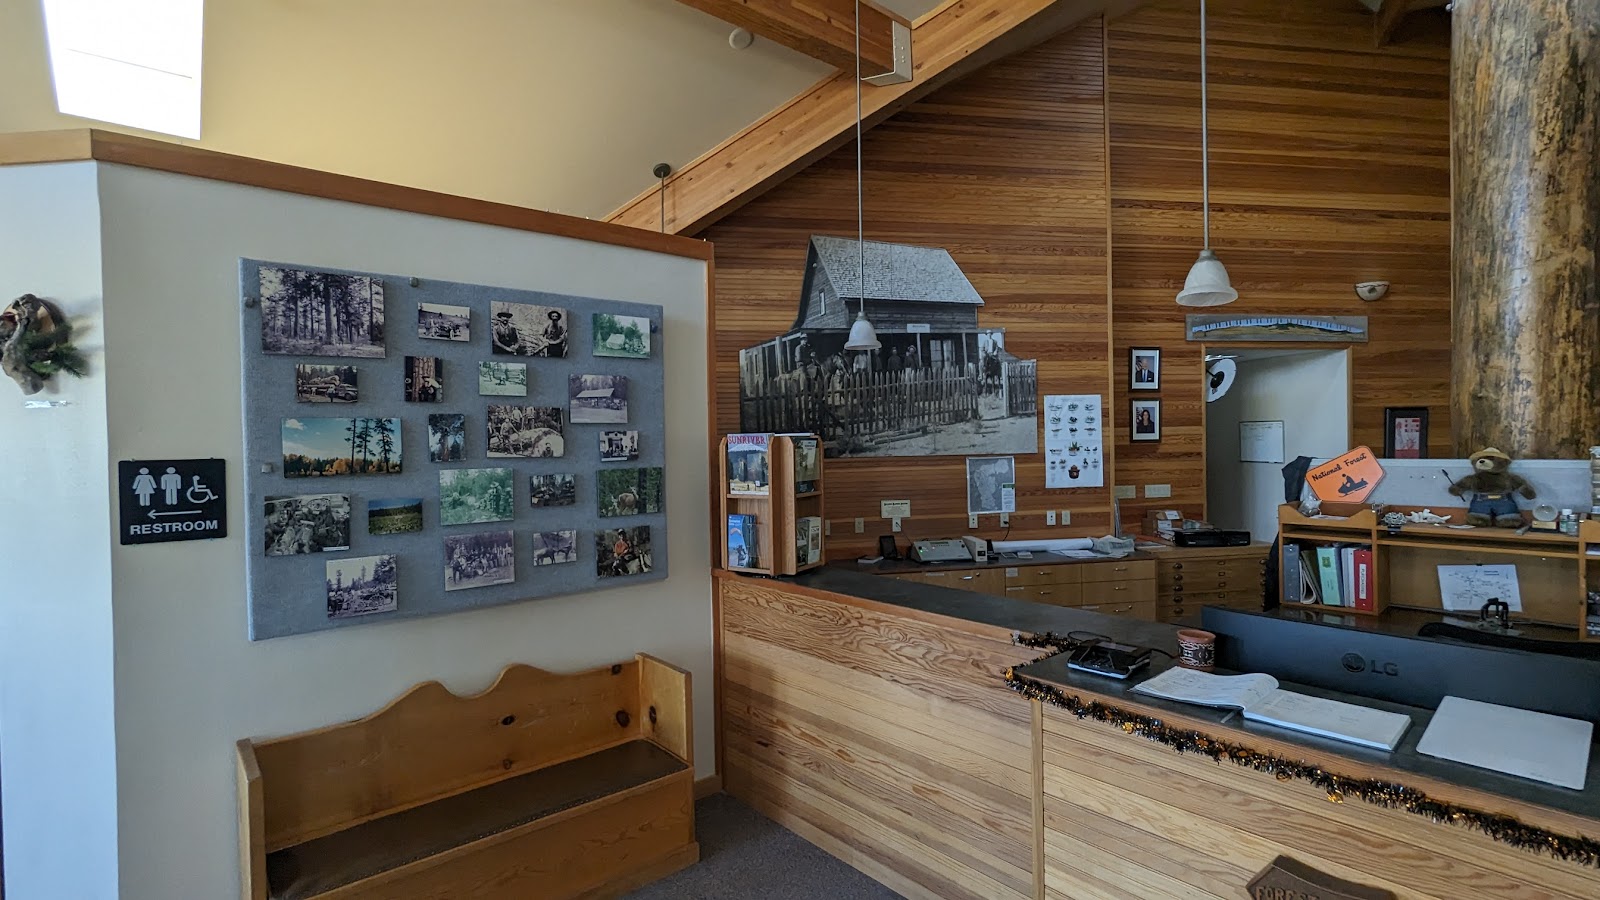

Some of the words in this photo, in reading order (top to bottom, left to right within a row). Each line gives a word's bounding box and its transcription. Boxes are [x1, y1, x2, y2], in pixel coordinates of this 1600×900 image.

[727, 435, 766, 445] SUNRIVER
[1311, 463, 1343, 482] National
[1343, 452, 1367, 467] Forest
[130, 519, 218, 536] RESTROOM
[1370, 659, 1399, 677] LG
